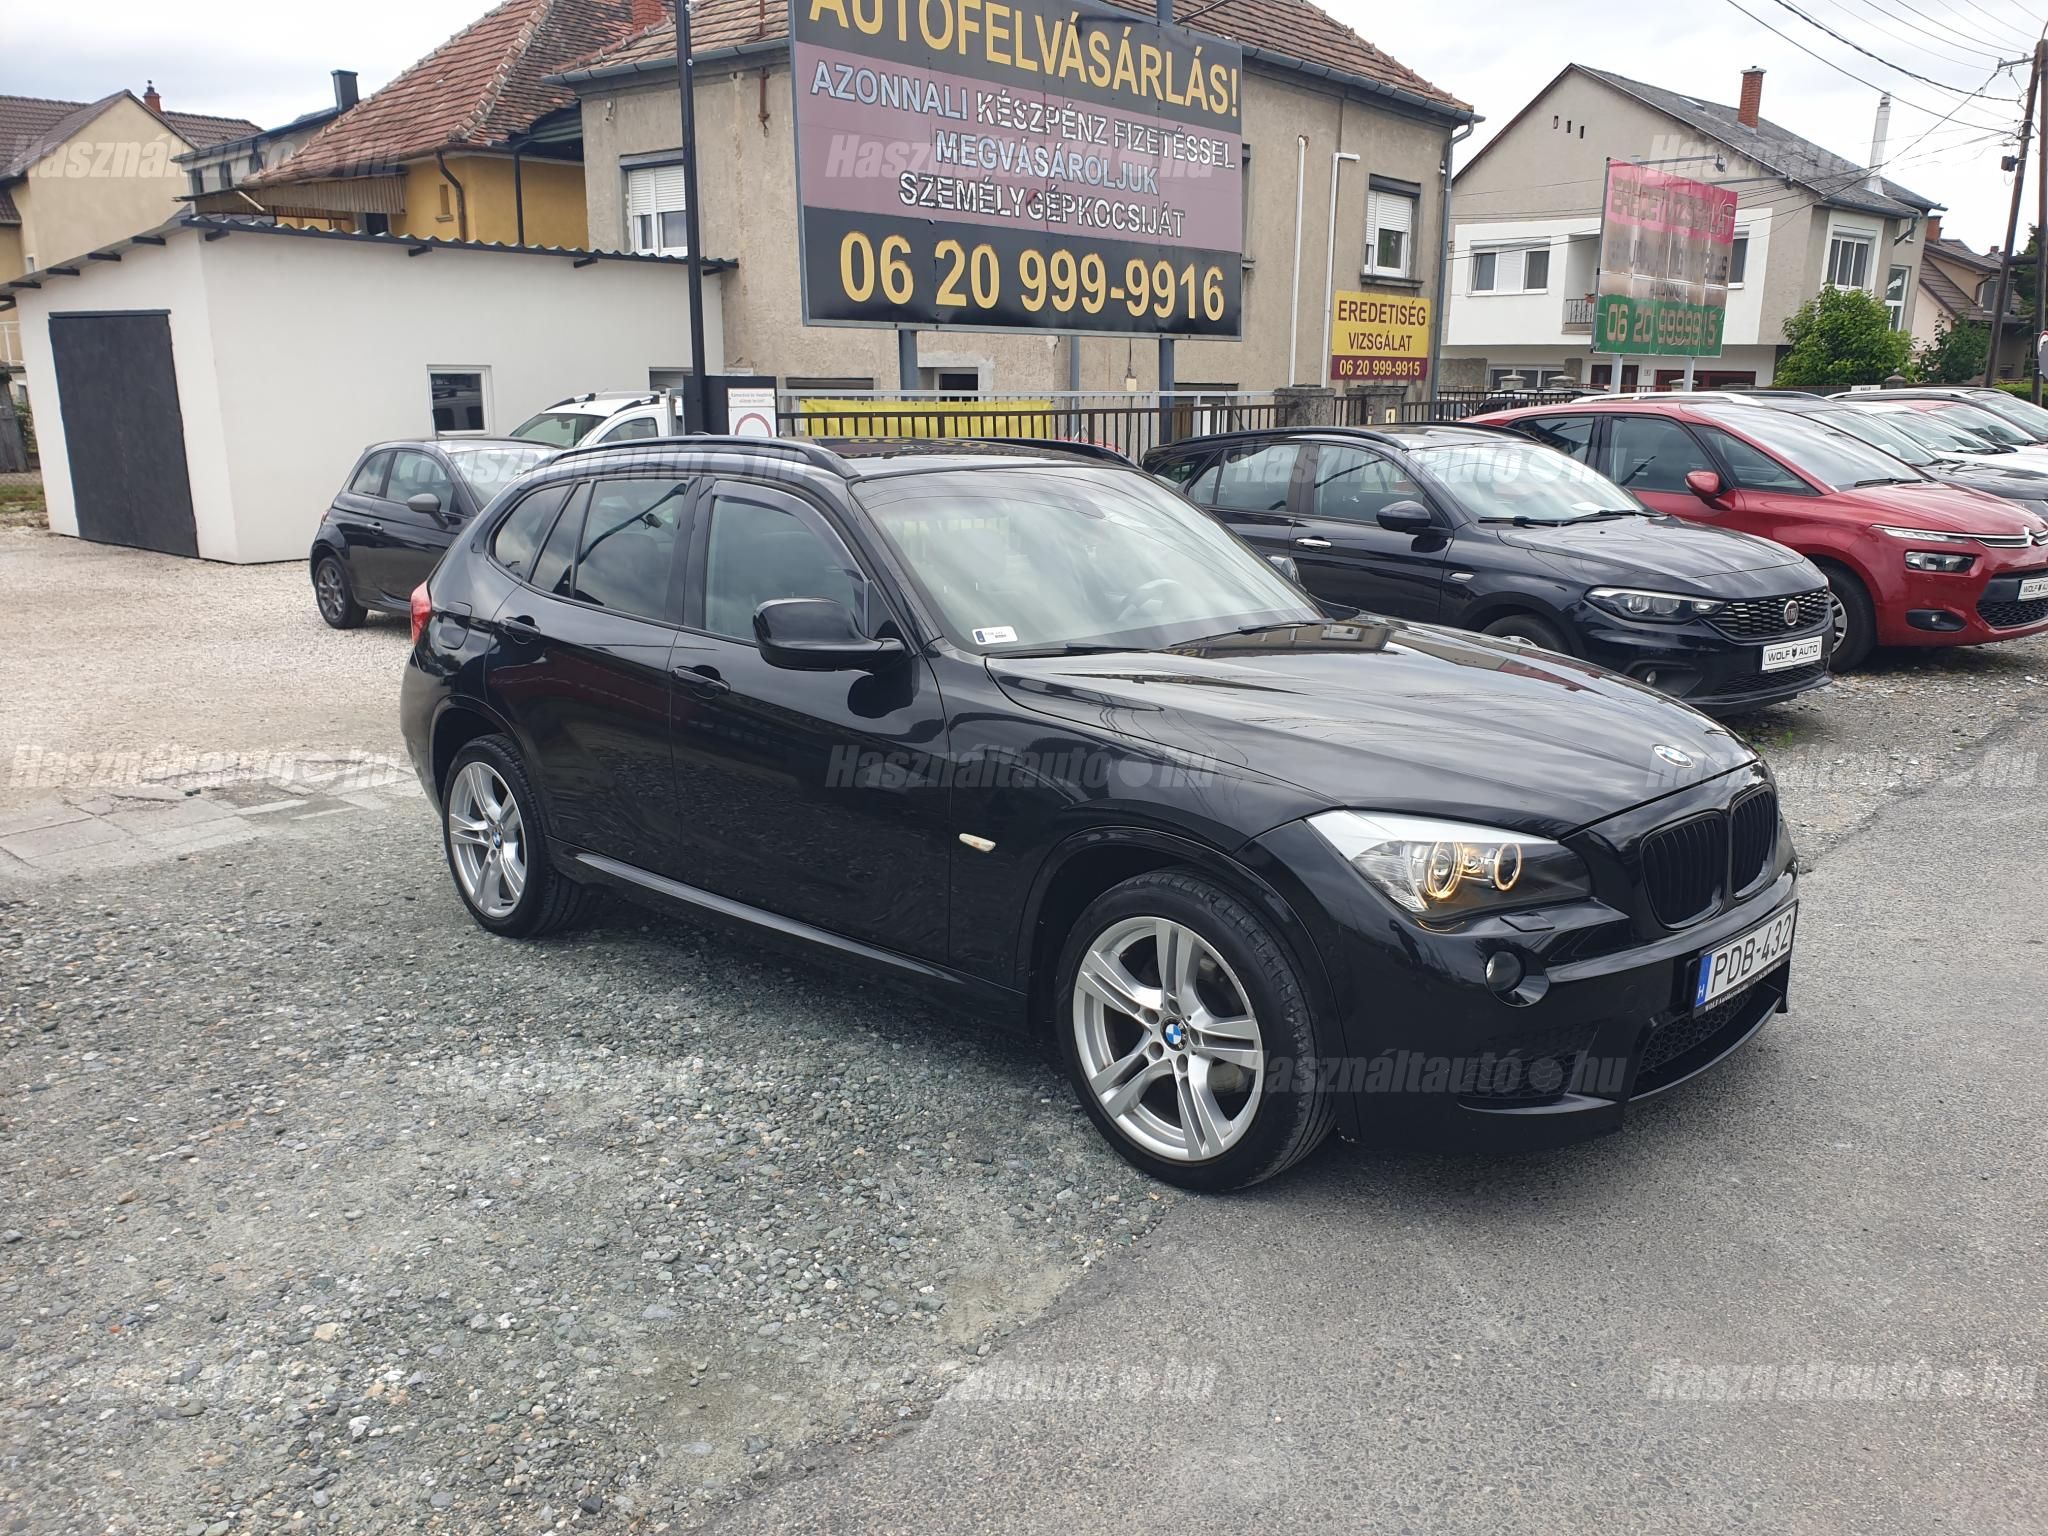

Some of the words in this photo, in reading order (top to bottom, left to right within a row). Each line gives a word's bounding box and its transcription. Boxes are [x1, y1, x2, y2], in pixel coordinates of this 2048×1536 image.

[810, 60, 968, 120] AZONNALI
[977, 88, 1108, 145] KÉSZPÉNZ
[1113, 119, 1236, 169] FIZETÉSSEL
[935, 129, 1159, 195] MEGVÁSÁROLJUK
[899, 172, 1185, 238] SZEMÉLYGÉPKOCSIJÁT
[840, 231, 914, 305] 06
[934, 239, 999, 309] 20
[1018, 249, 1225, 321] 999-9916
[1338, 300, 1426, 326] EREDETISÉG
[1606, 304, 1629, 342] 06
[1632, 306, 1652, 343] 20
[1348, 330, 1412, 351] VIZSGÁLAT
[1339, 359, 1354, 375] 06
[1356, 359, 1369, 375] 20
[1372, 360, 1420, 376] 999-9915
[1768, 650, 1790, 661] WOLF
[1799, 645, 1817, 656] AUTO
[1711, 913, 1791, 993] PDB-432
[1697, 984, 1705, 999] H
